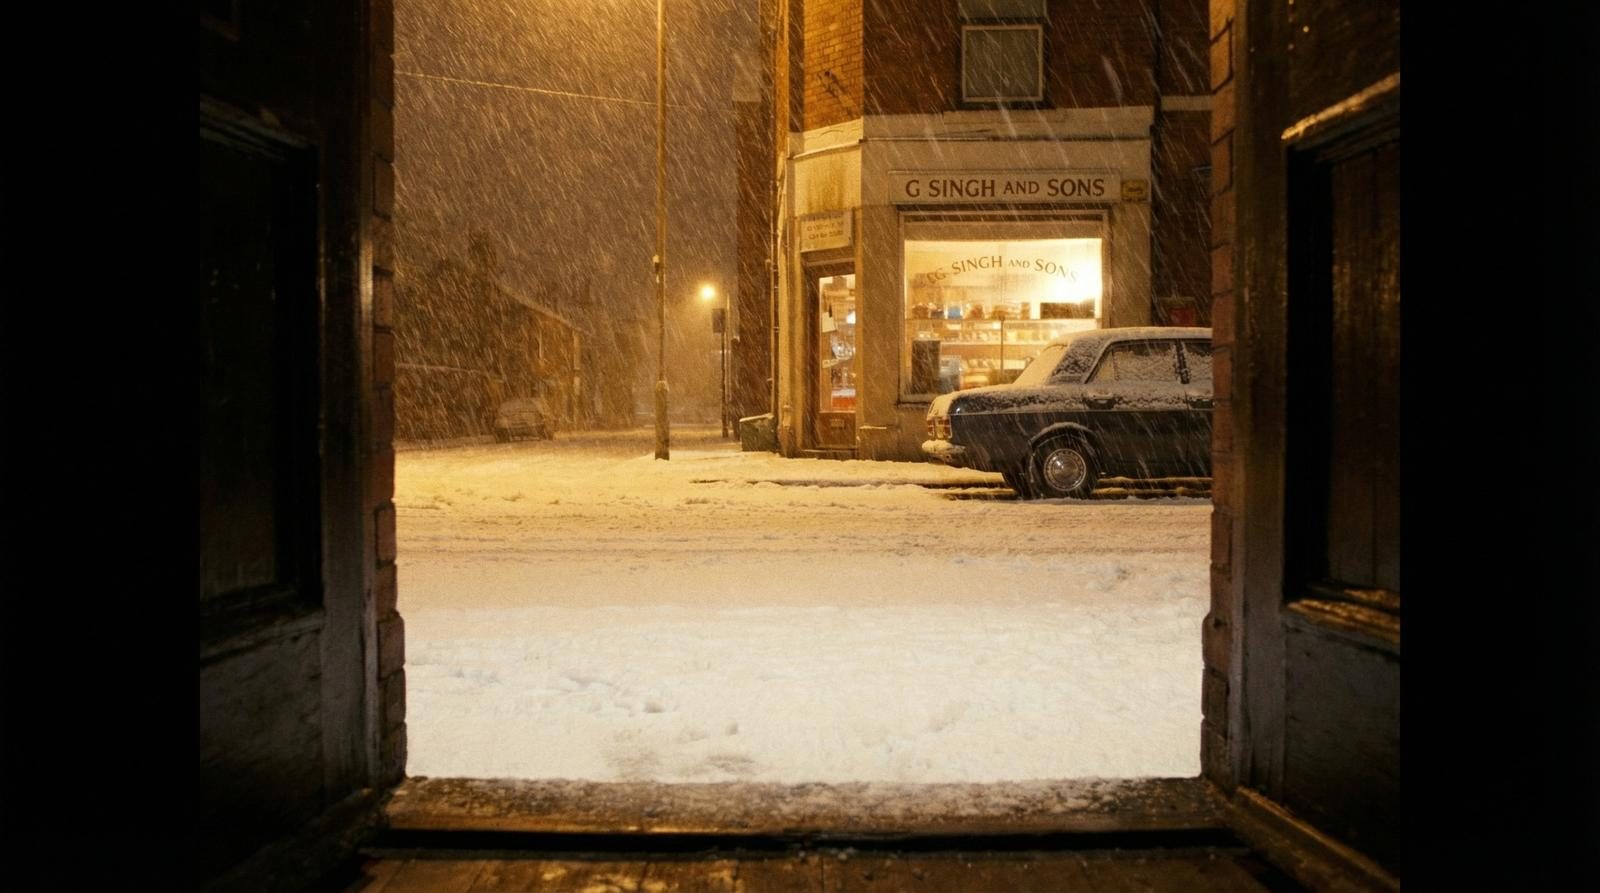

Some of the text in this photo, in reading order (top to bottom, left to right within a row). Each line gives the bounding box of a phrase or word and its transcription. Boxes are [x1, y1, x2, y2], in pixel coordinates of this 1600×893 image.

[905, 179, 920, 198] G
[928, 179, 995, 198] SINGH
[1003, 181, 1040, 194] AND
[1047, 178, 1105, 197] SONS
[951, 255, 1002, 275] SINGH
[1008, 259, 1031, 269] AND
[1034, 258, 1079, 282] SONS
